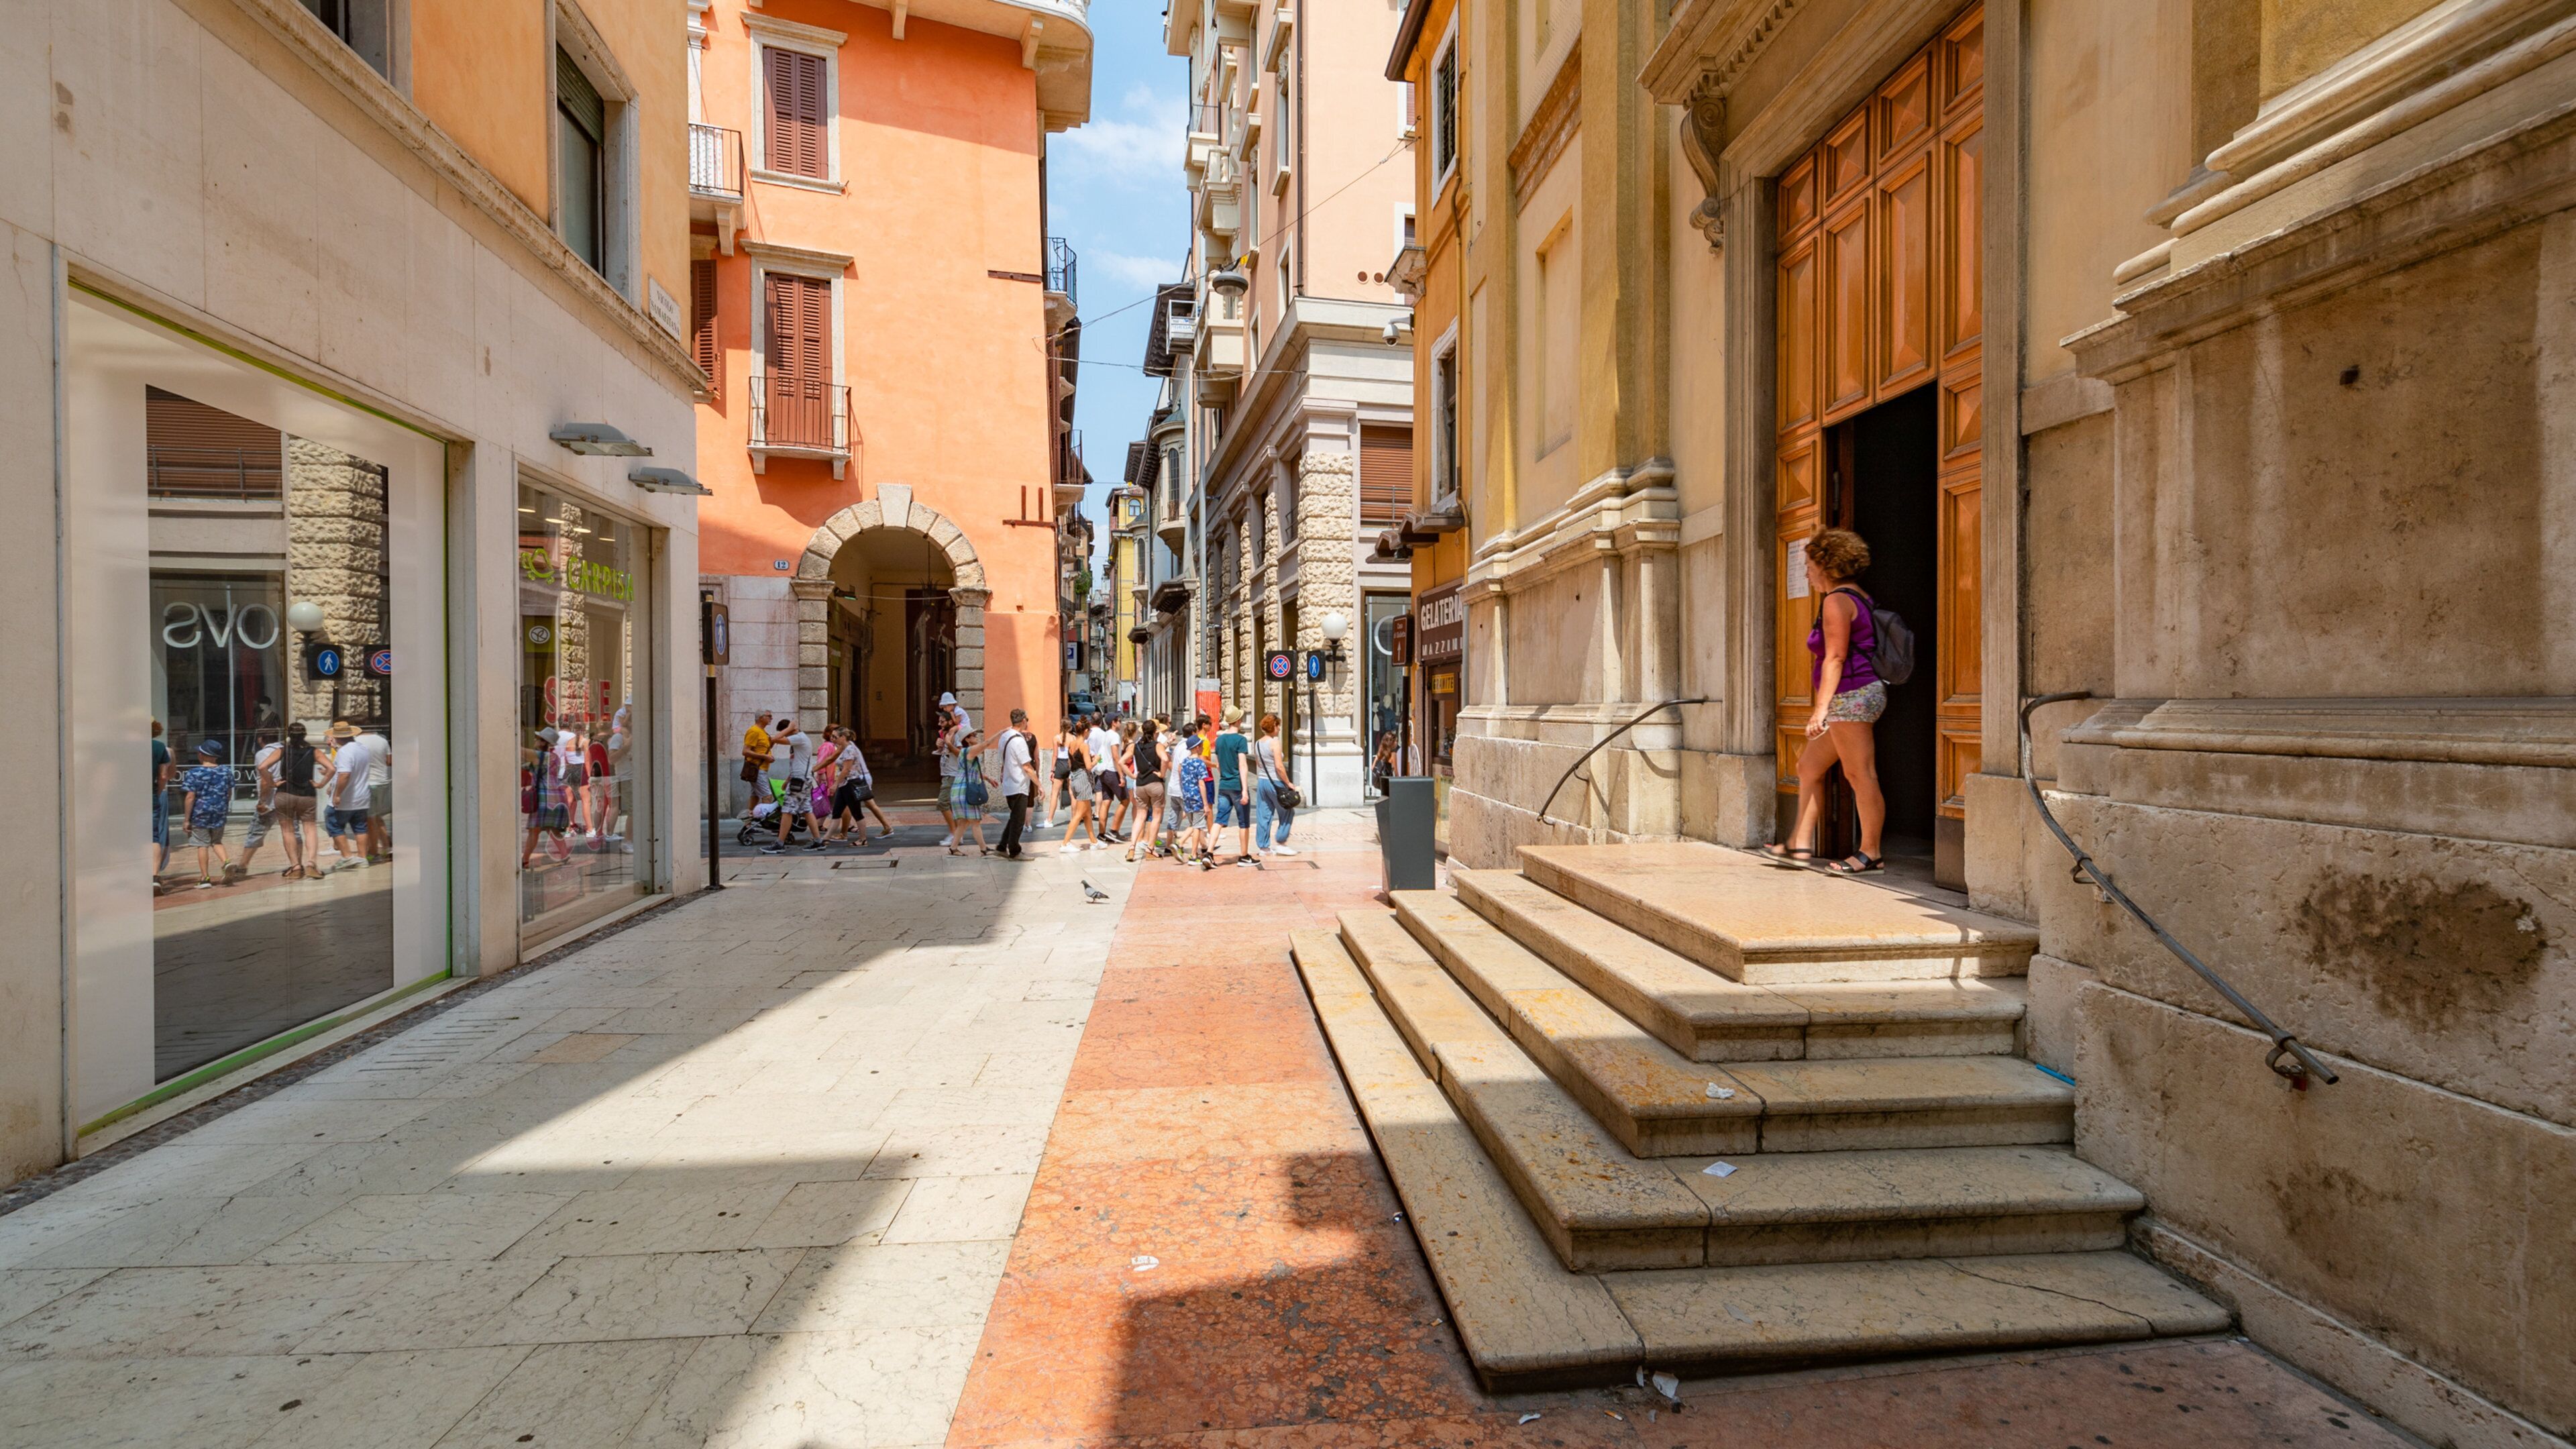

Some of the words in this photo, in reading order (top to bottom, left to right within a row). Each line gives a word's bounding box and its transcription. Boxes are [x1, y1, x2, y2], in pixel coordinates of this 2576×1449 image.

[657, 290, 674, 314] VICOLO
[568, 556, 634, 602] CARPISA
[1421, 594, 1463, 631] GELATERIA
[1422, 637, 1463, 656] MAZZINI
[544, 676, 611, 724] SALE
